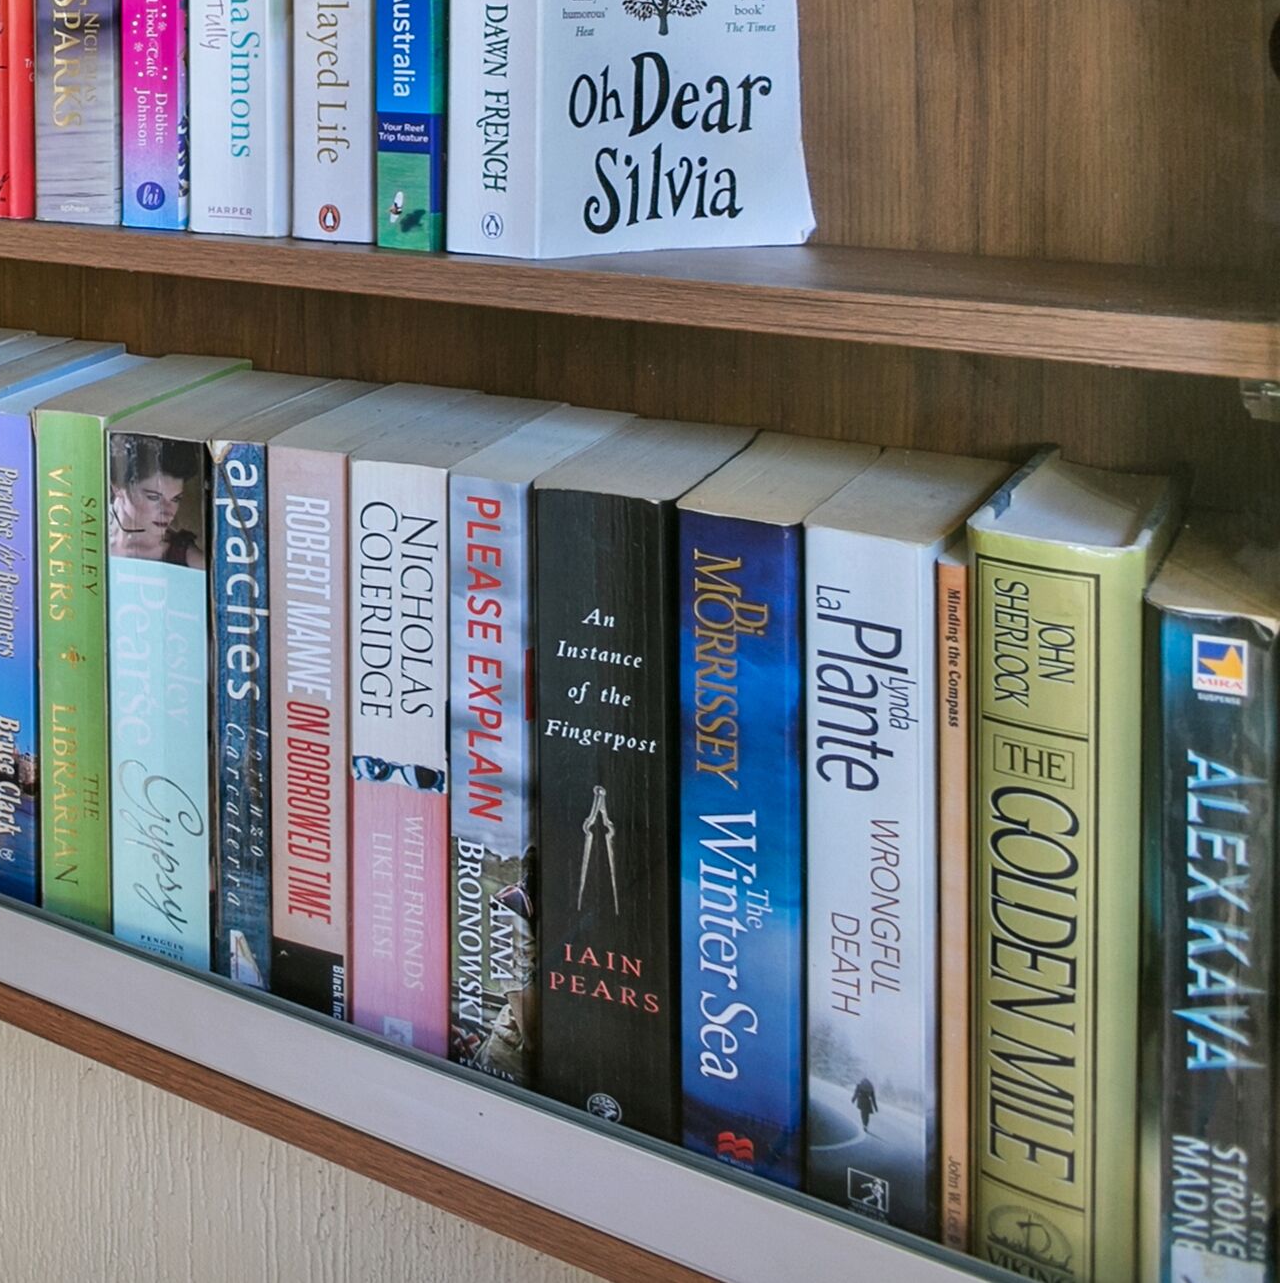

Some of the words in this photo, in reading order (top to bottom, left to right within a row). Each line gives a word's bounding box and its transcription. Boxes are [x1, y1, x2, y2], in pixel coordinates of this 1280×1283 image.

[229, 29, 262, 159] Simons
[483, 2, 510, 78] DAWN
[568, 66, 624, 129] Oh
[628, 51, 773, 137] Dear
[574, 25, 595, 37] Heat
[481, 88, 511, 194] FRENCH
[583, 140, 745, 235] Silvia
[47, 463, 75, 623] VICKERS
[79, 493, 100, 599] SALLEY
[213, 456, 271, 704] apaches
[358, 499, 402, 720] COLERIDGE
[463, 493, 503, 649] PLEASE
[399, 511, 440, 720] NICHOLAS
[556, 638, 644, 670] Instance
[692, 547, 740, 791] MORRISSEY
[466, 655, 505, 825] EXPLAIN
[543, 717, 658, 755] Fingerpost
[815, 610, 904, 794] Plante
[50, 701, 78, 888] LIBRARIAN
[82, 772, 100, 823] THE
[118, 757, 205, 936] Gypsy
[563, 942, 643, 978] IAIN
[829, 908, 862, 1019] DEATH
[868, 817, 902, 996] WRONGFUL
[986, 783, 1082, 1026] GOLDEN
[548, 969, 661, 1015] PEARS
[986, 1029, 1080, 1187] MILE
